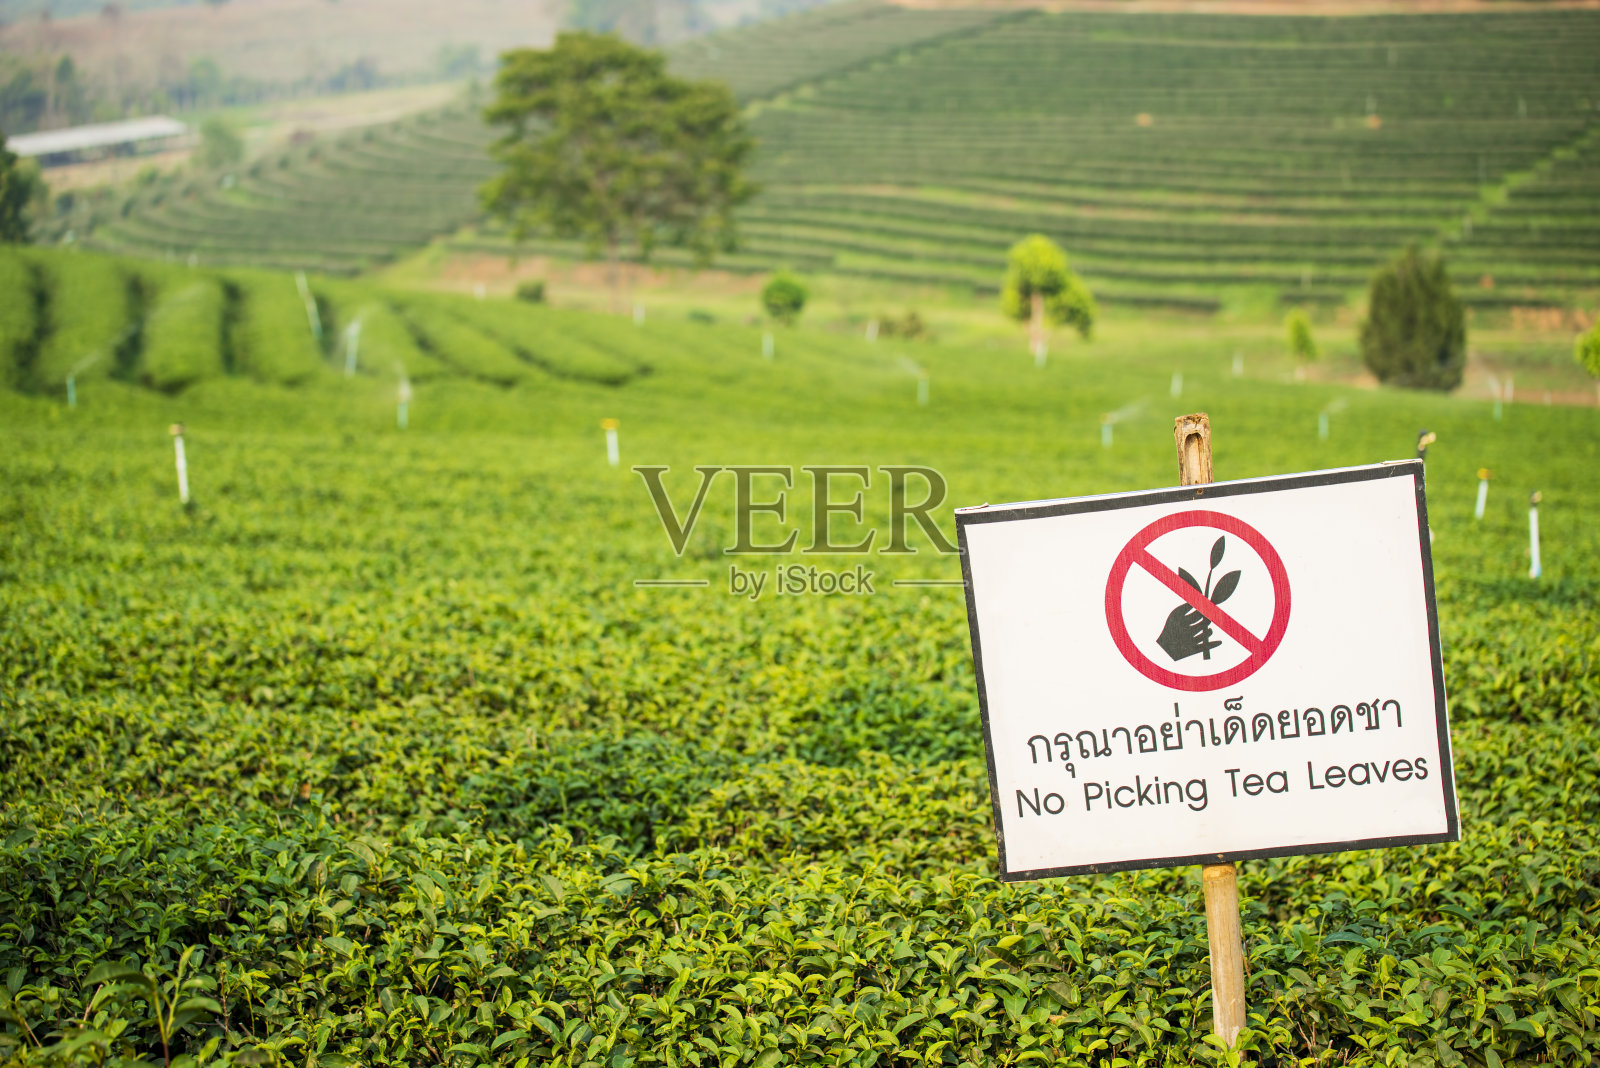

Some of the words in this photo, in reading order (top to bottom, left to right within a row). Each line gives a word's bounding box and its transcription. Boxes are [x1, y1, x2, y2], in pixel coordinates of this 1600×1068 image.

[1027, 695, 1402, 778] กรุณาอย่าเด็ดยอดชา
[1016, 789, 1065, 817] No
[1084, 775, 1208, 811] Picking
[1225, 768, 1288, 797] Tea
[1307, 757, 1428, 790] Leaves
